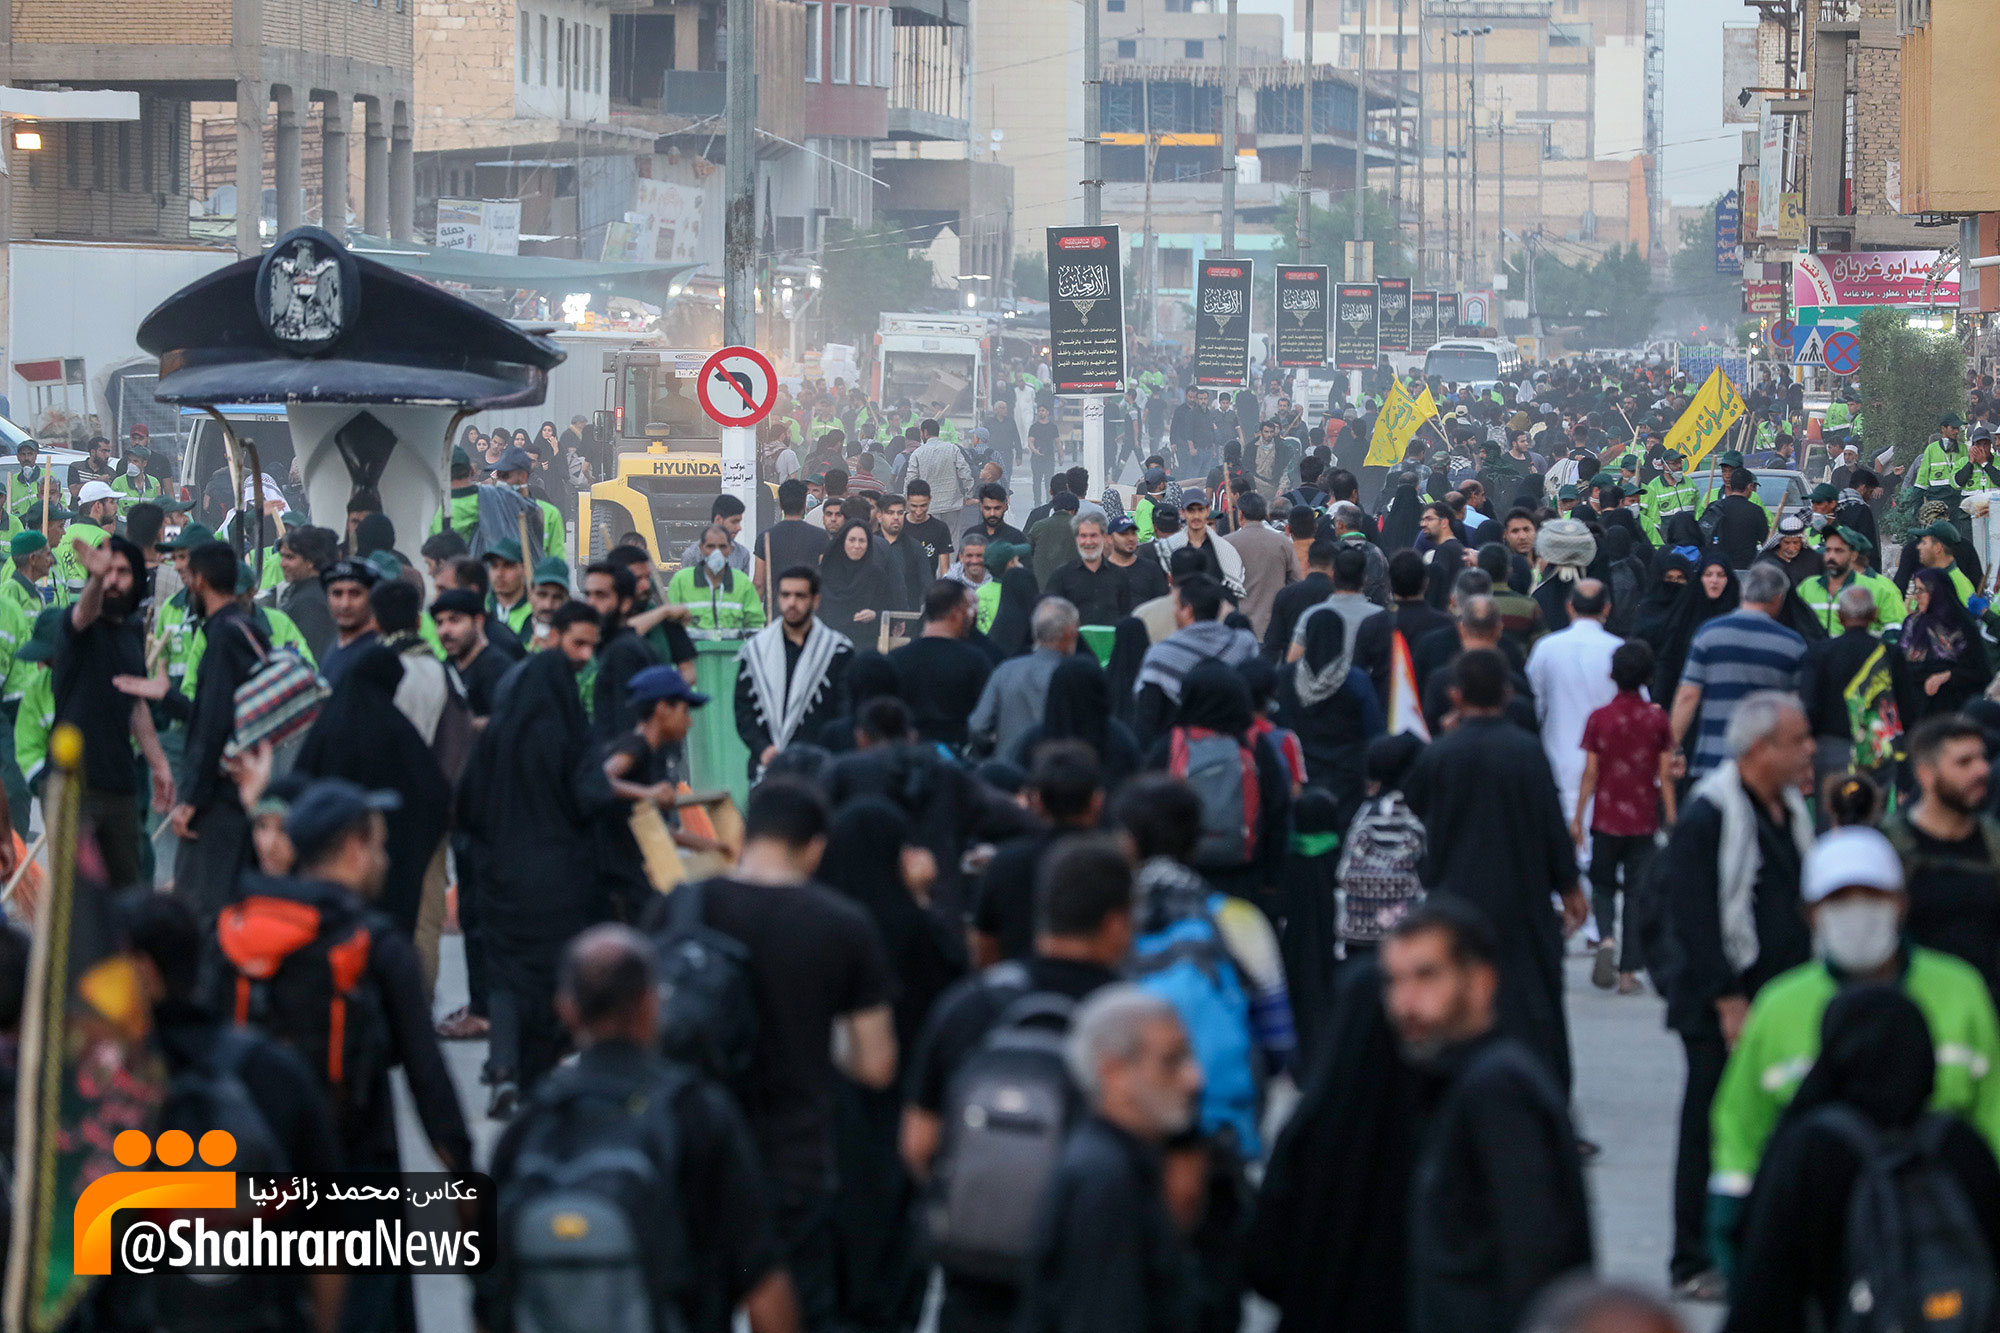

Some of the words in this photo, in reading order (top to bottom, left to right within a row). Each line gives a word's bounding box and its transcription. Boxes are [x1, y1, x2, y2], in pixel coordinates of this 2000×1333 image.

[1799, 257, 1820, 279] فقط
[1832, 254, 1883, 283] غربان
[1886, 257, 1908, 282] ابو
[1861, 289, 1874, 298] مواد
[1882, 289, 1900, 299] عطور
[653, 462, 722, 476] HYUNDA
